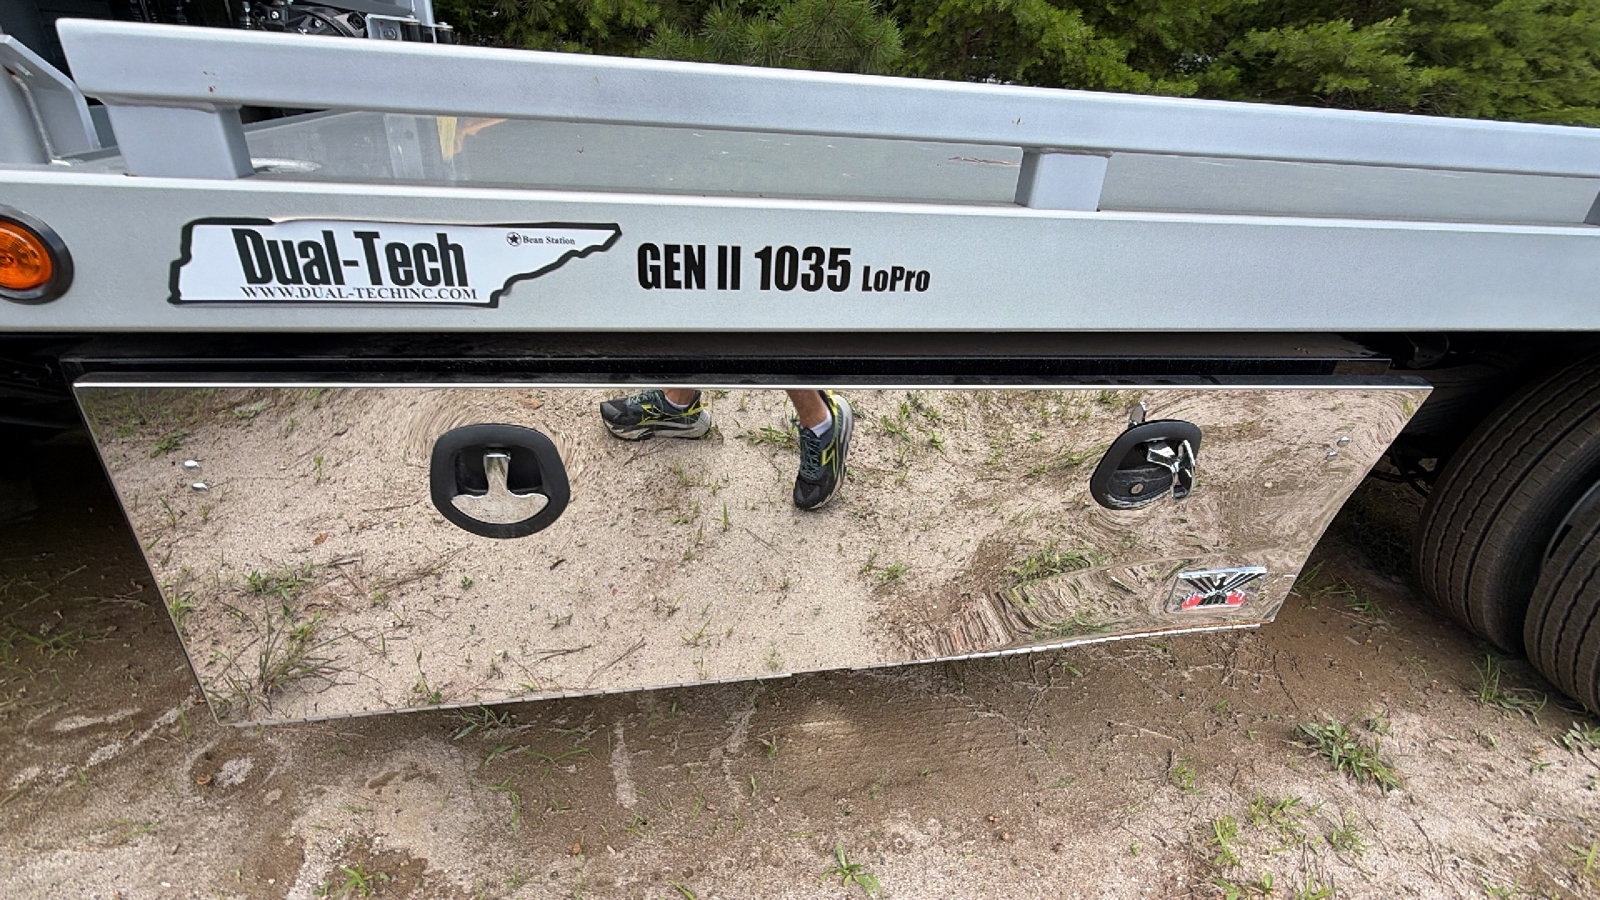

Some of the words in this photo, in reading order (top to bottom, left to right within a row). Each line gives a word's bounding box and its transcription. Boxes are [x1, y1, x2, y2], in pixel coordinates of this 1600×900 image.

[522, 235, 544, 244] Bean
[546, 236, 575, 245] Station
[231, 228, 468, 287] Dual-Tech
[637, 242, 706, 290] GEN
[717, 245, 741, 290] II
[754, 245, 852, 292] 1035
[861, 265, 931, 292] LoPro
[240, 286, 478, 300] WWW.DUAL-TECHINC.COM
